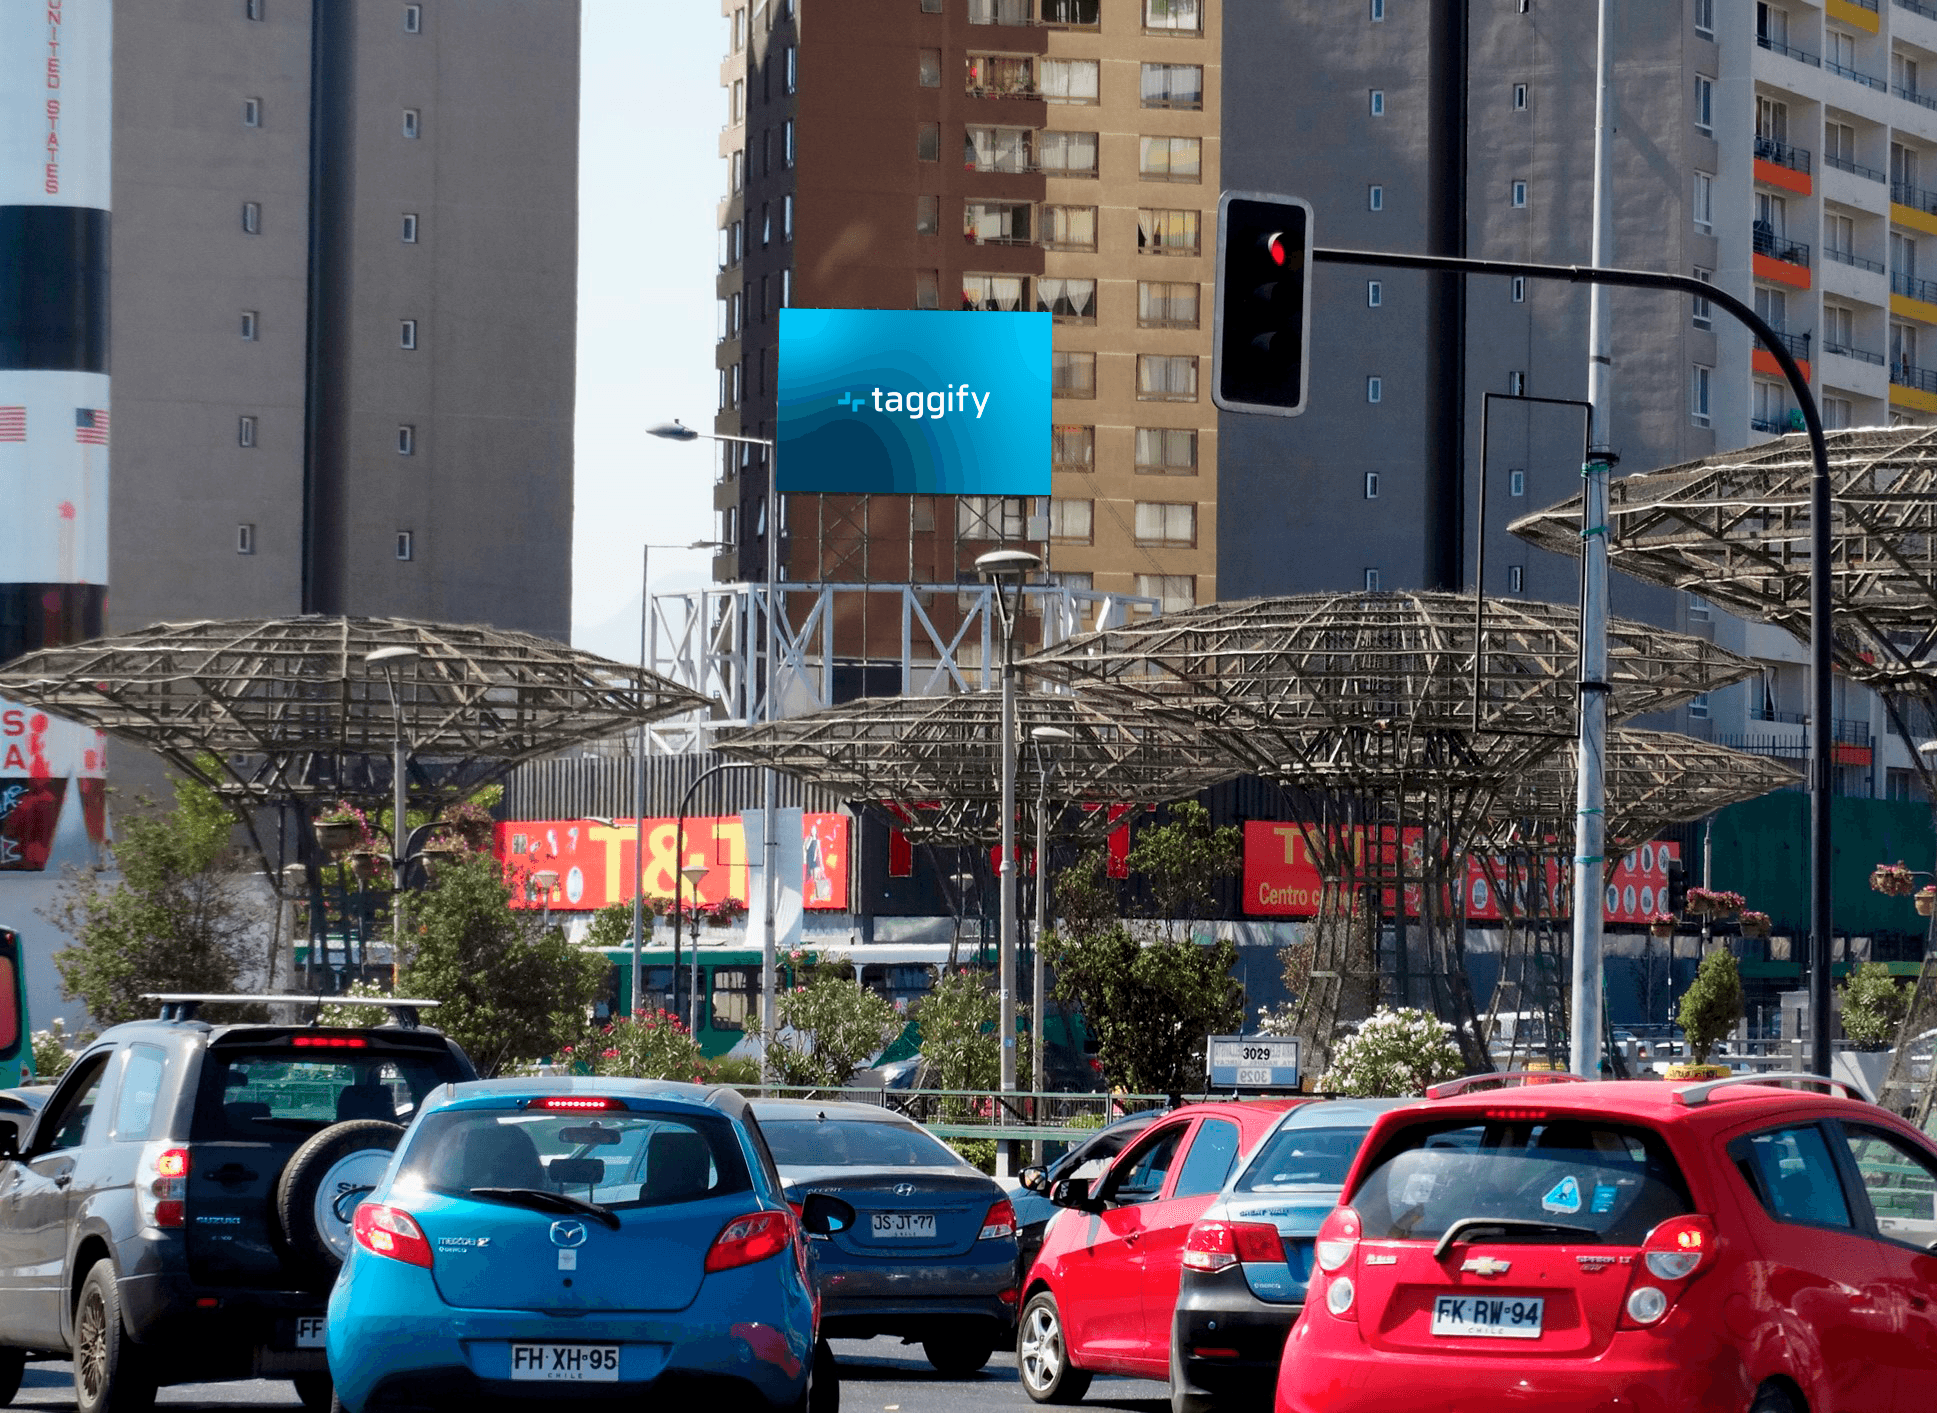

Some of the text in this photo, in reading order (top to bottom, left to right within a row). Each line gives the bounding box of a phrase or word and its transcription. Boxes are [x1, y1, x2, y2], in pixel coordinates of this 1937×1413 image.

[45, 99, 60, 195] STATES
[871, 384, 990, 419] taggify
[1259, 881, 1308, 906] Centro
[1243, 1047, 1271, 1061] 3029
[196, 1216, 241, 1225] SUZUKI
